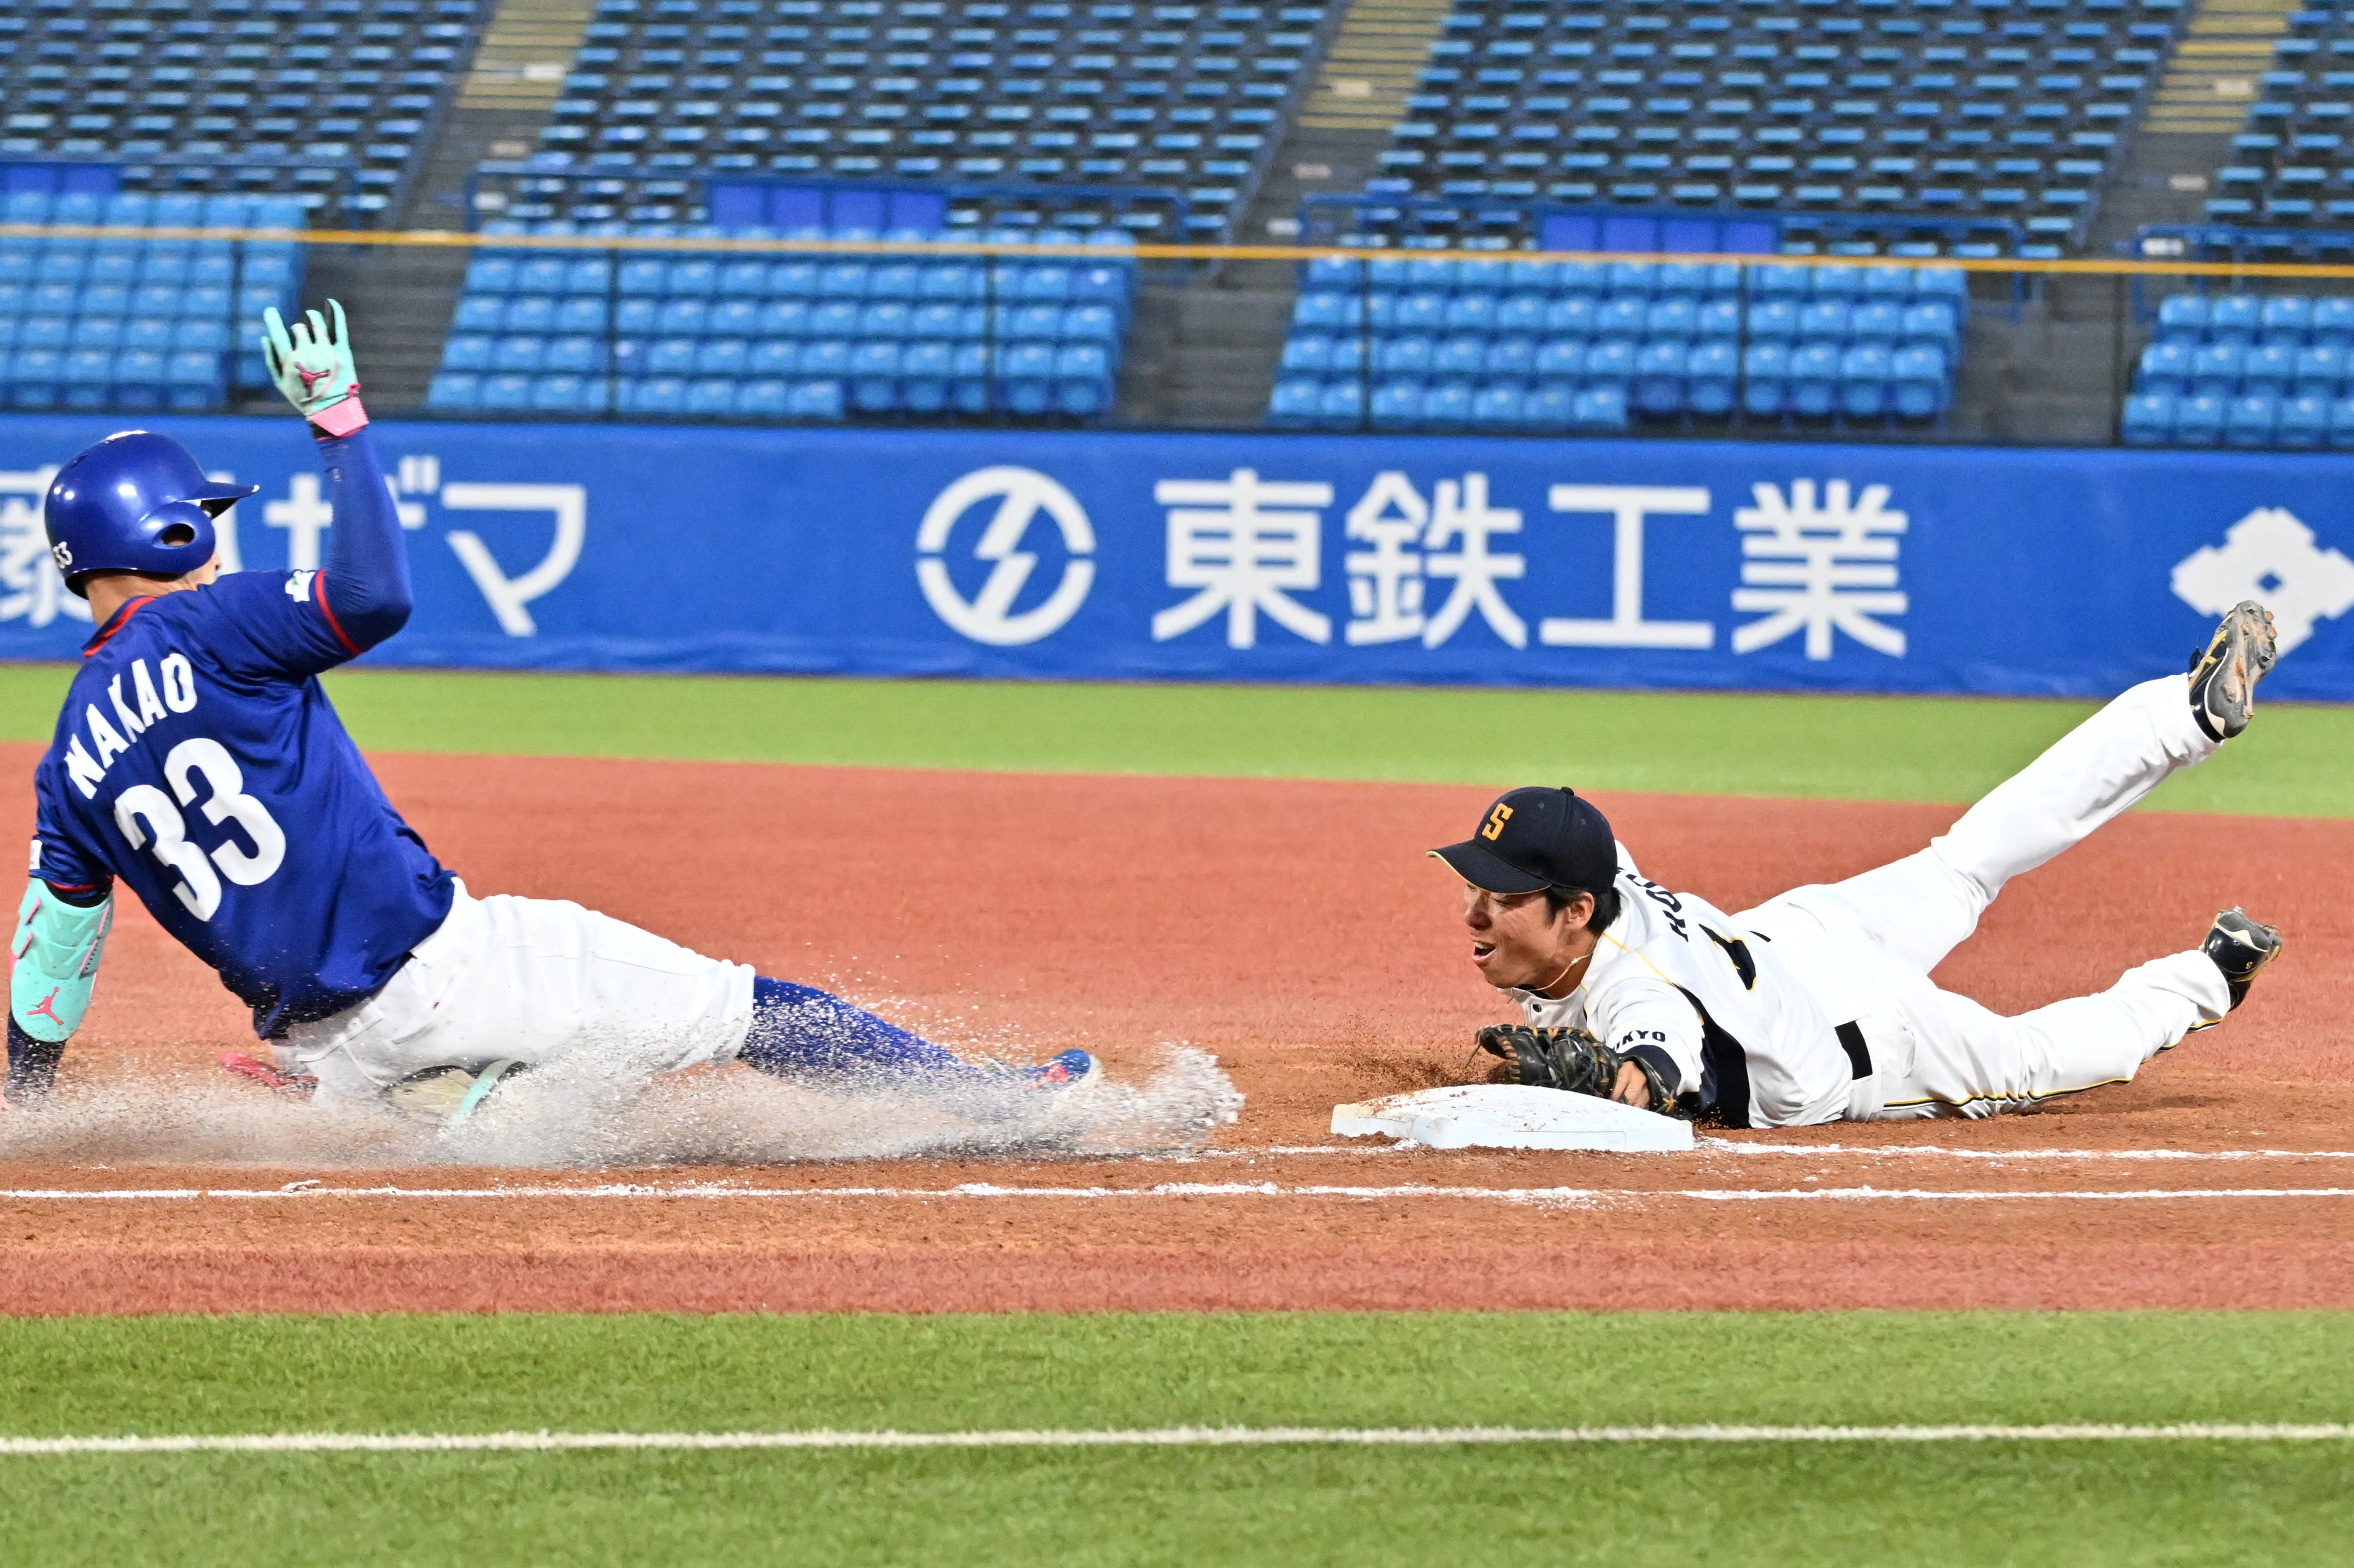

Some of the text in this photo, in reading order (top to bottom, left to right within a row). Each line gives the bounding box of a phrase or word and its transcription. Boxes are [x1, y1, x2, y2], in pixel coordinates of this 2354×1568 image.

[1153, 468, 1908, 660] 東鉄工業
[64, 653, 197, 799] NAKAO
[114, 738, 286, 922] 33
[1481, 803, 1514, 841] S
